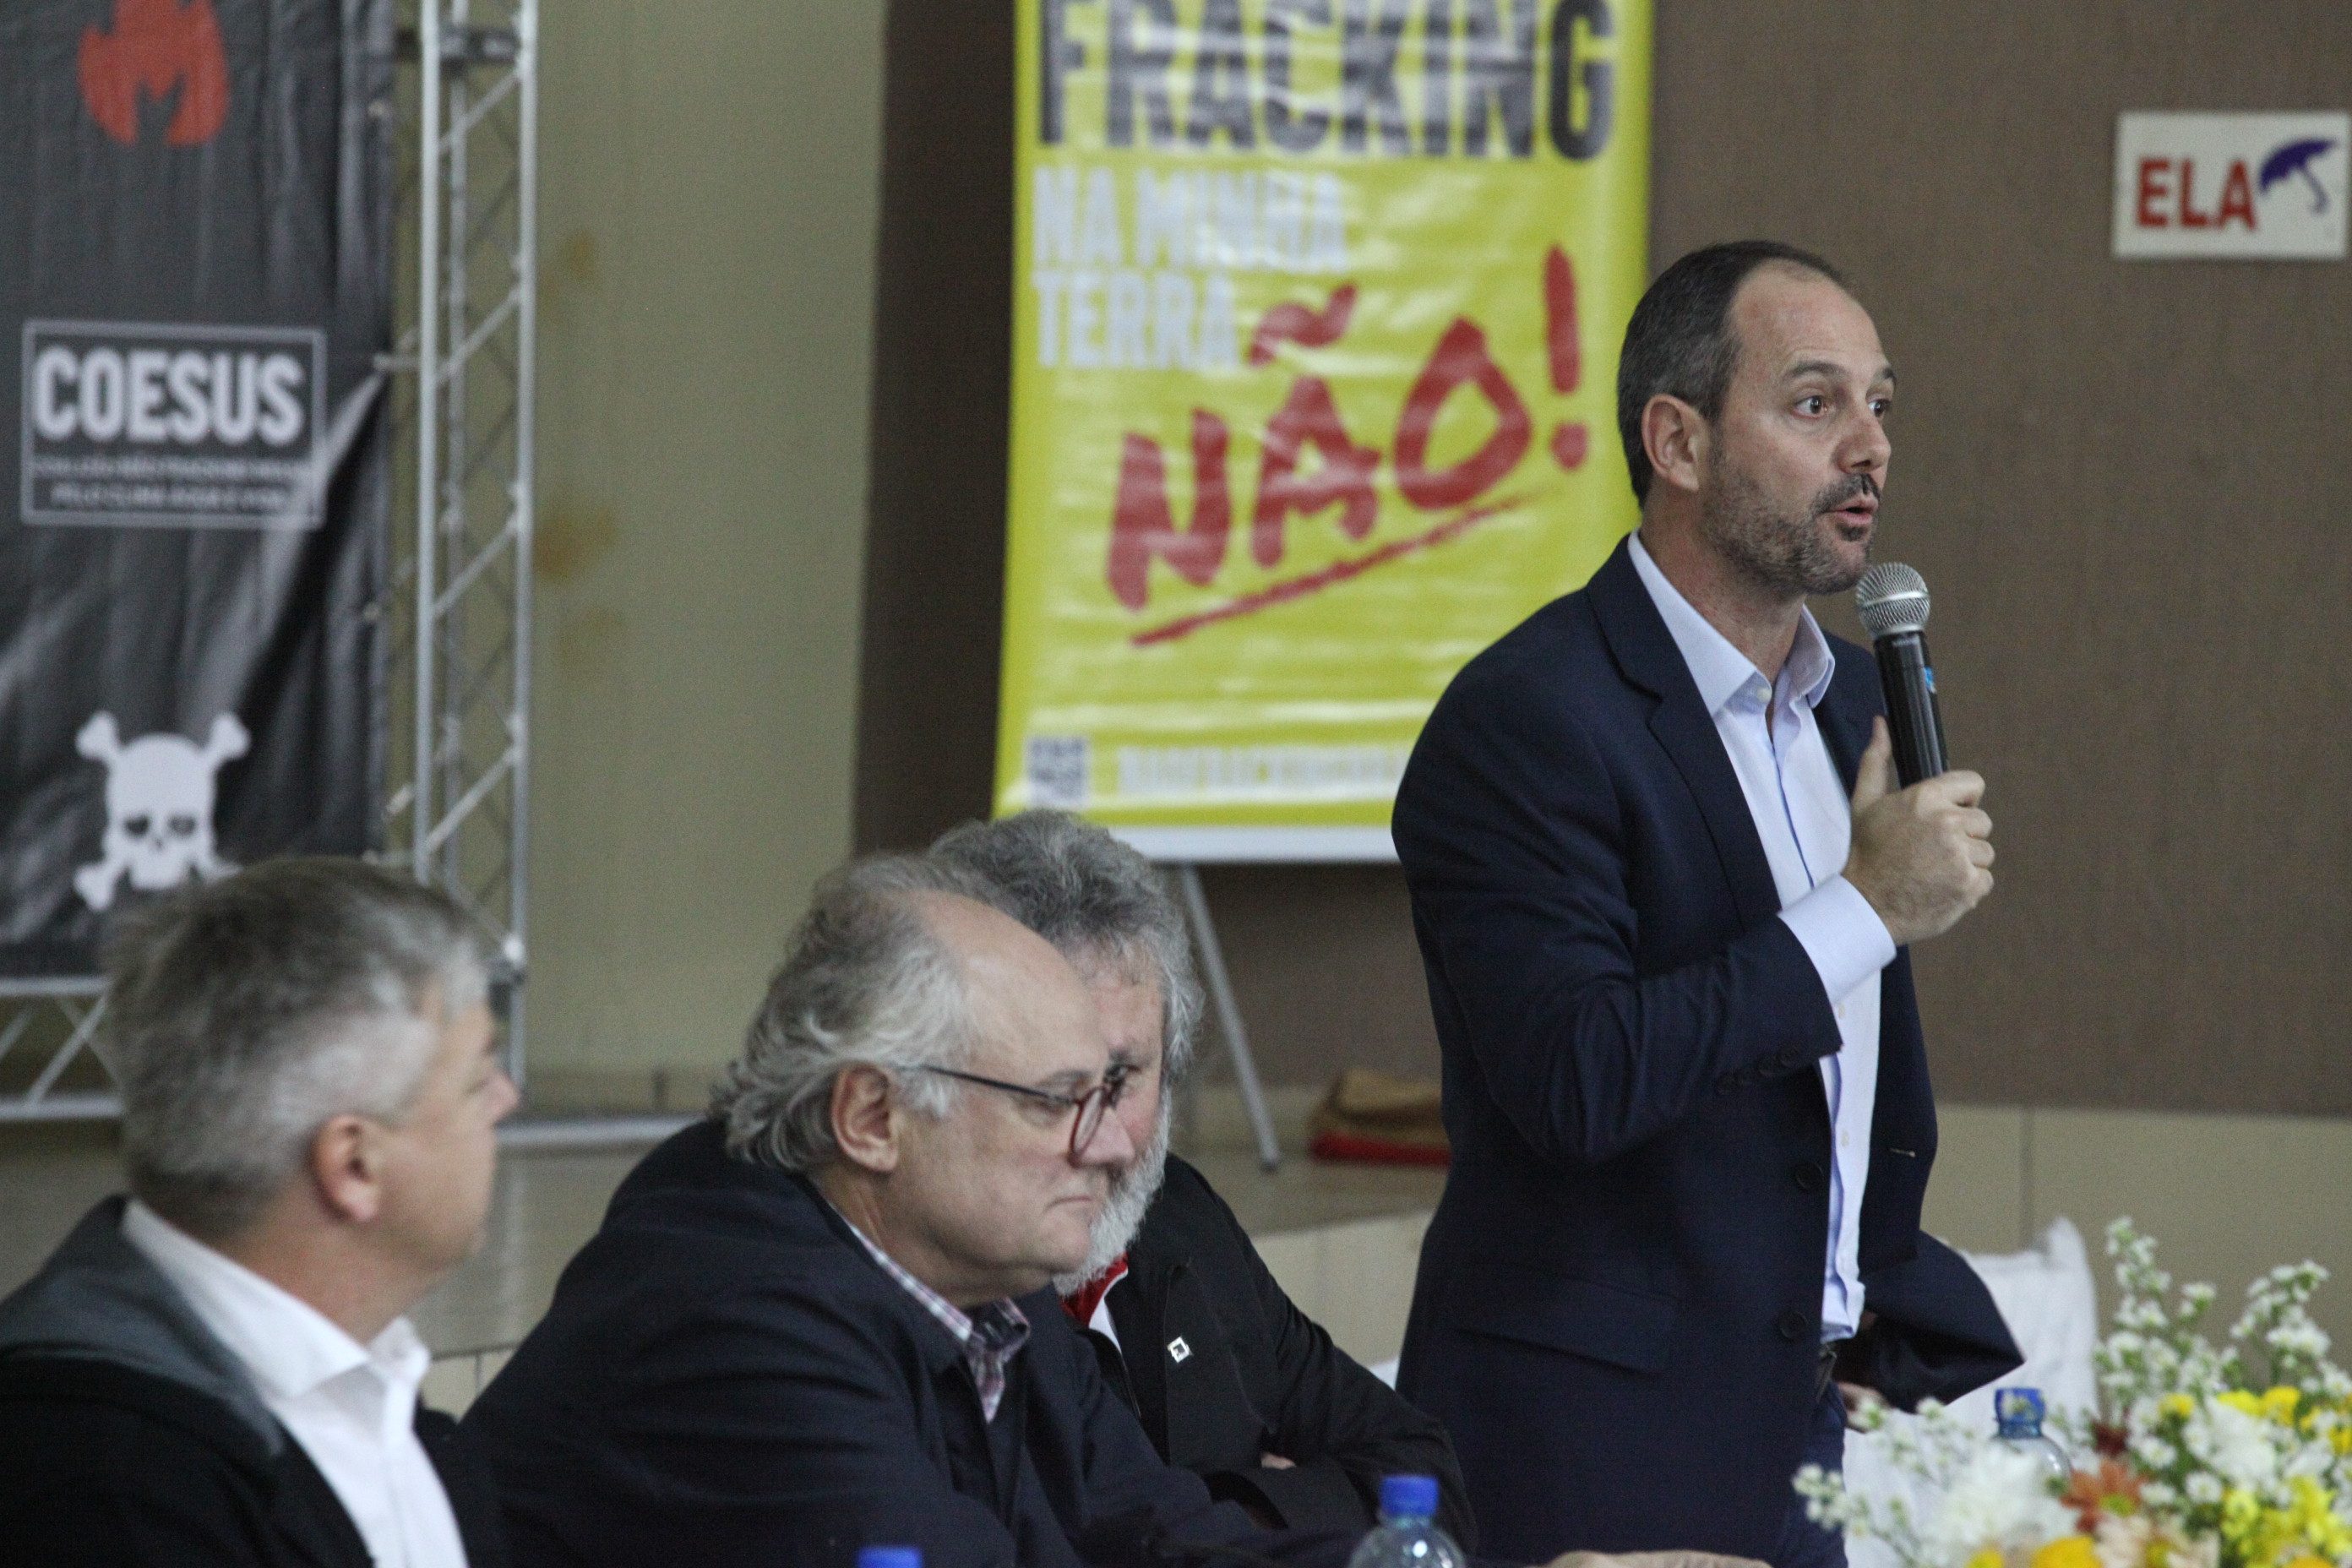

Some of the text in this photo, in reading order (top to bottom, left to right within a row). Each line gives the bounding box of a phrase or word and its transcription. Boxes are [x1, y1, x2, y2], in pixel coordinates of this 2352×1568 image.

[1038, 0, 1615, 160] FRACKING
[1032, 165, 1349, 273] NA MINHA
[2137, 155, 2257, 231] ELA
[1032, 270, 1241, 370] TERRA
[33, 345, 306, 445] COESUS
[1105, 242, 1588, 613] NÃO!
